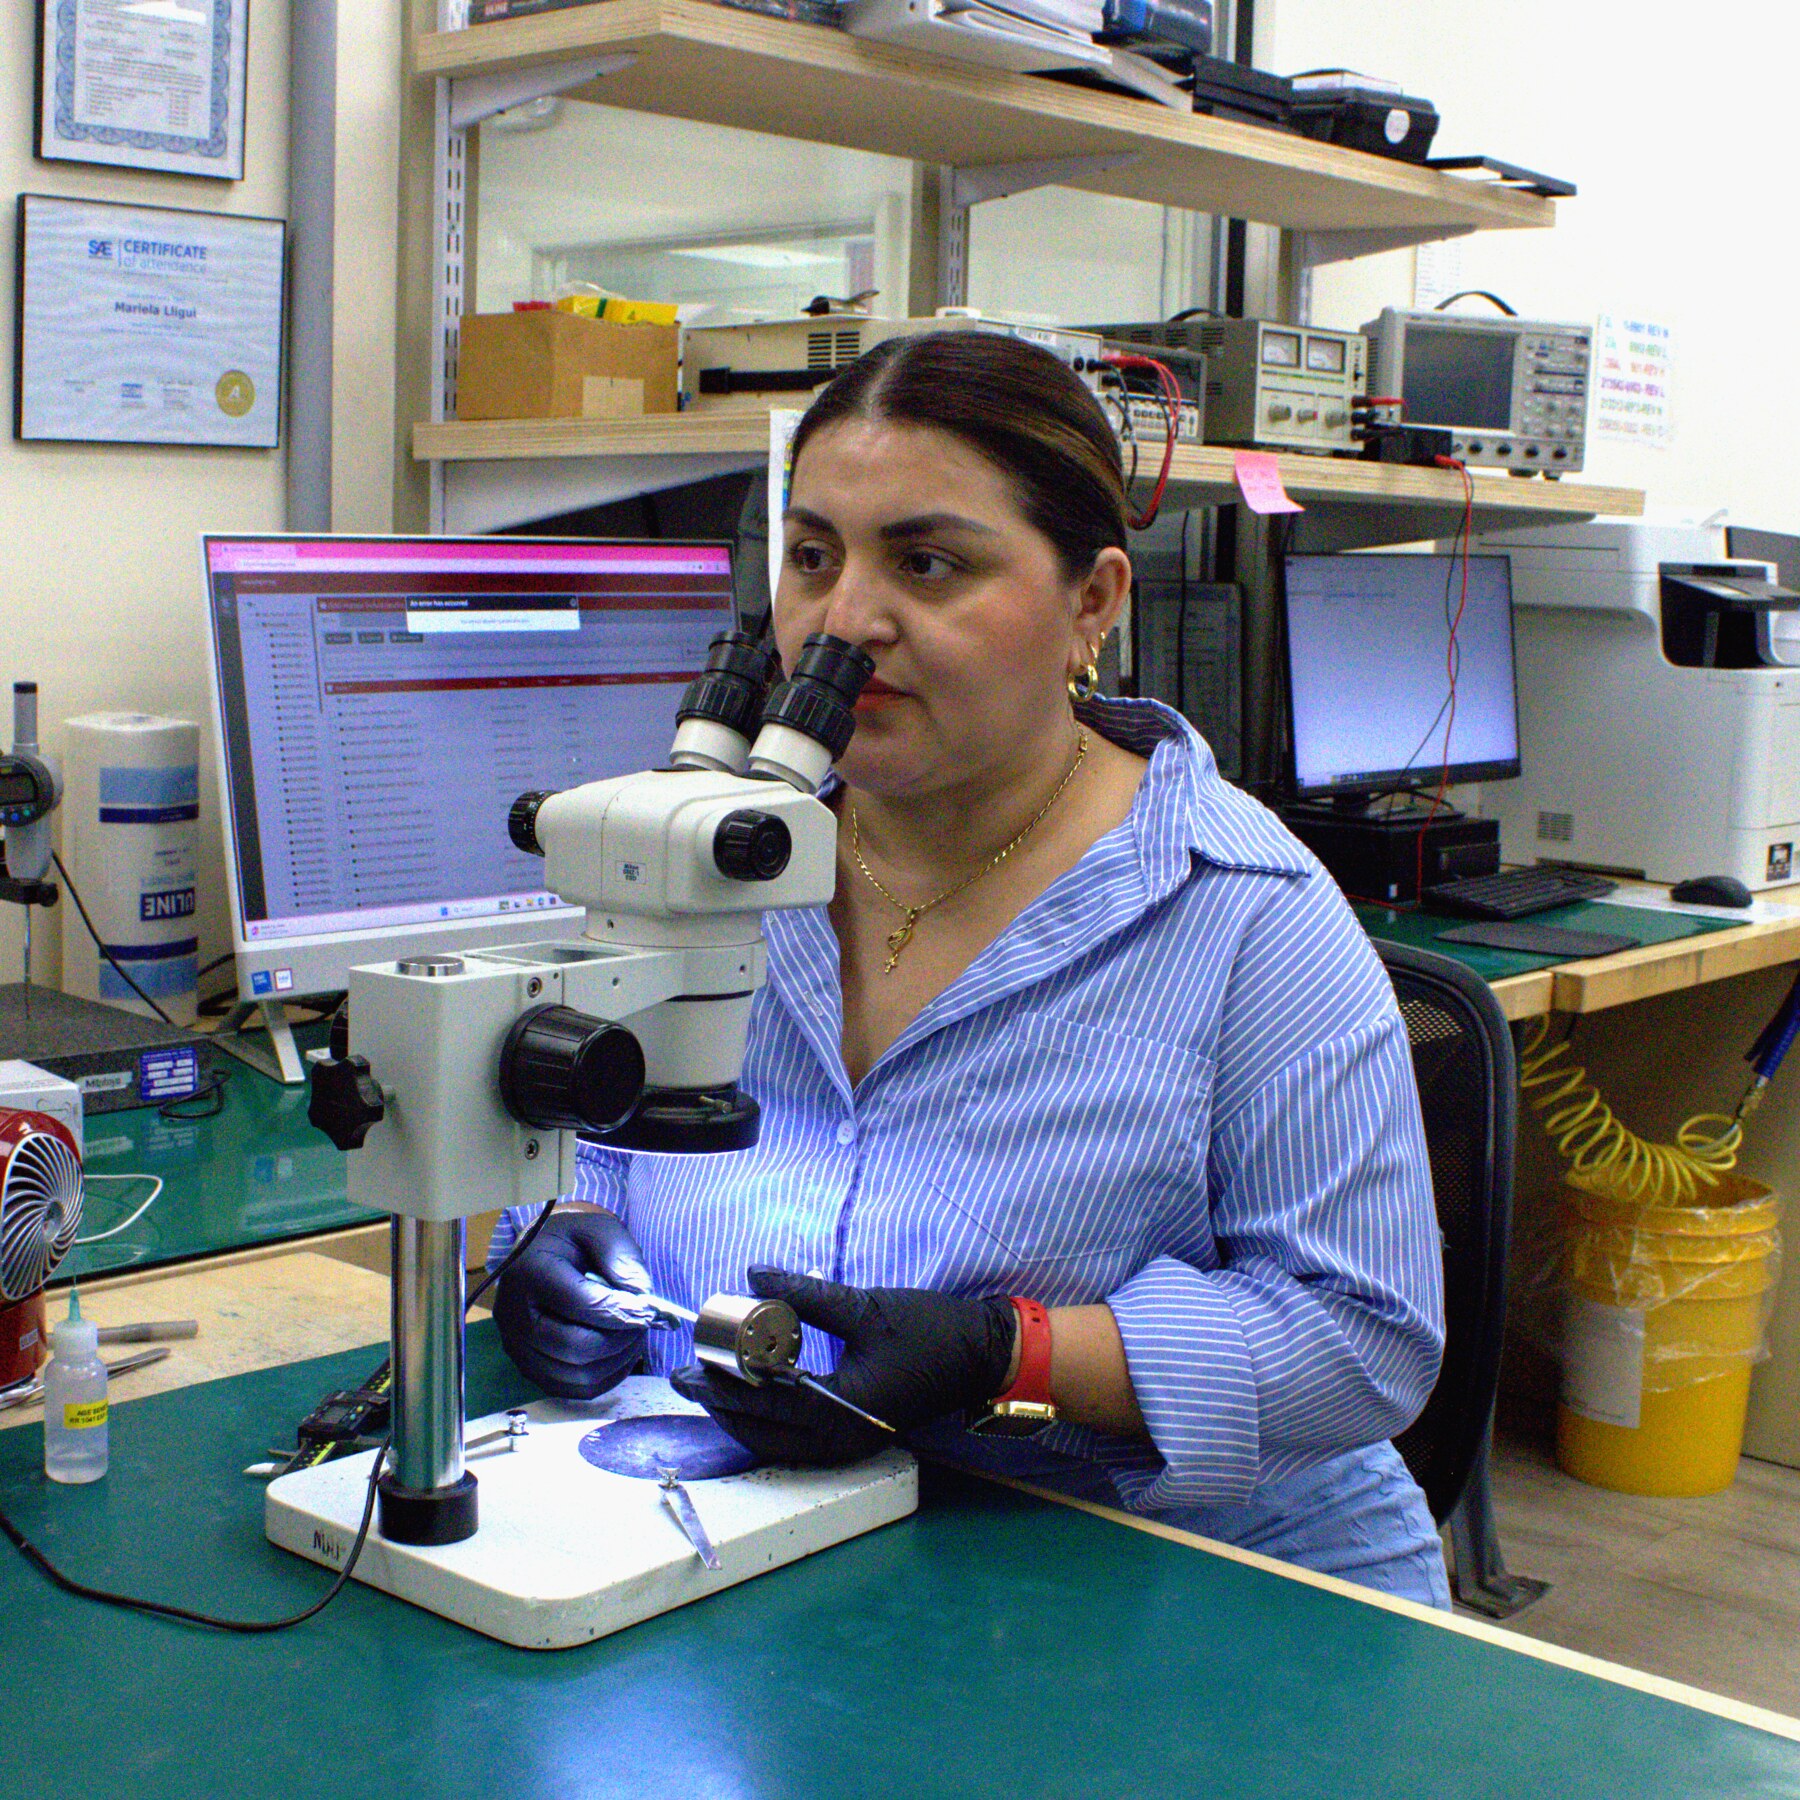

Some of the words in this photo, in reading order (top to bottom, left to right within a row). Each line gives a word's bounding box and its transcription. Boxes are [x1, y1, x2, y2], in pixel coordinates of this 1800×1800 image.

[123, 239, 208, 260] CERTIFICATE
[123, 257, 136, 268] of
[139, 258, 206, 274] attendance
[114, 301, 160, 315] Mariela
[143, 891, 194, 917] ULINE
